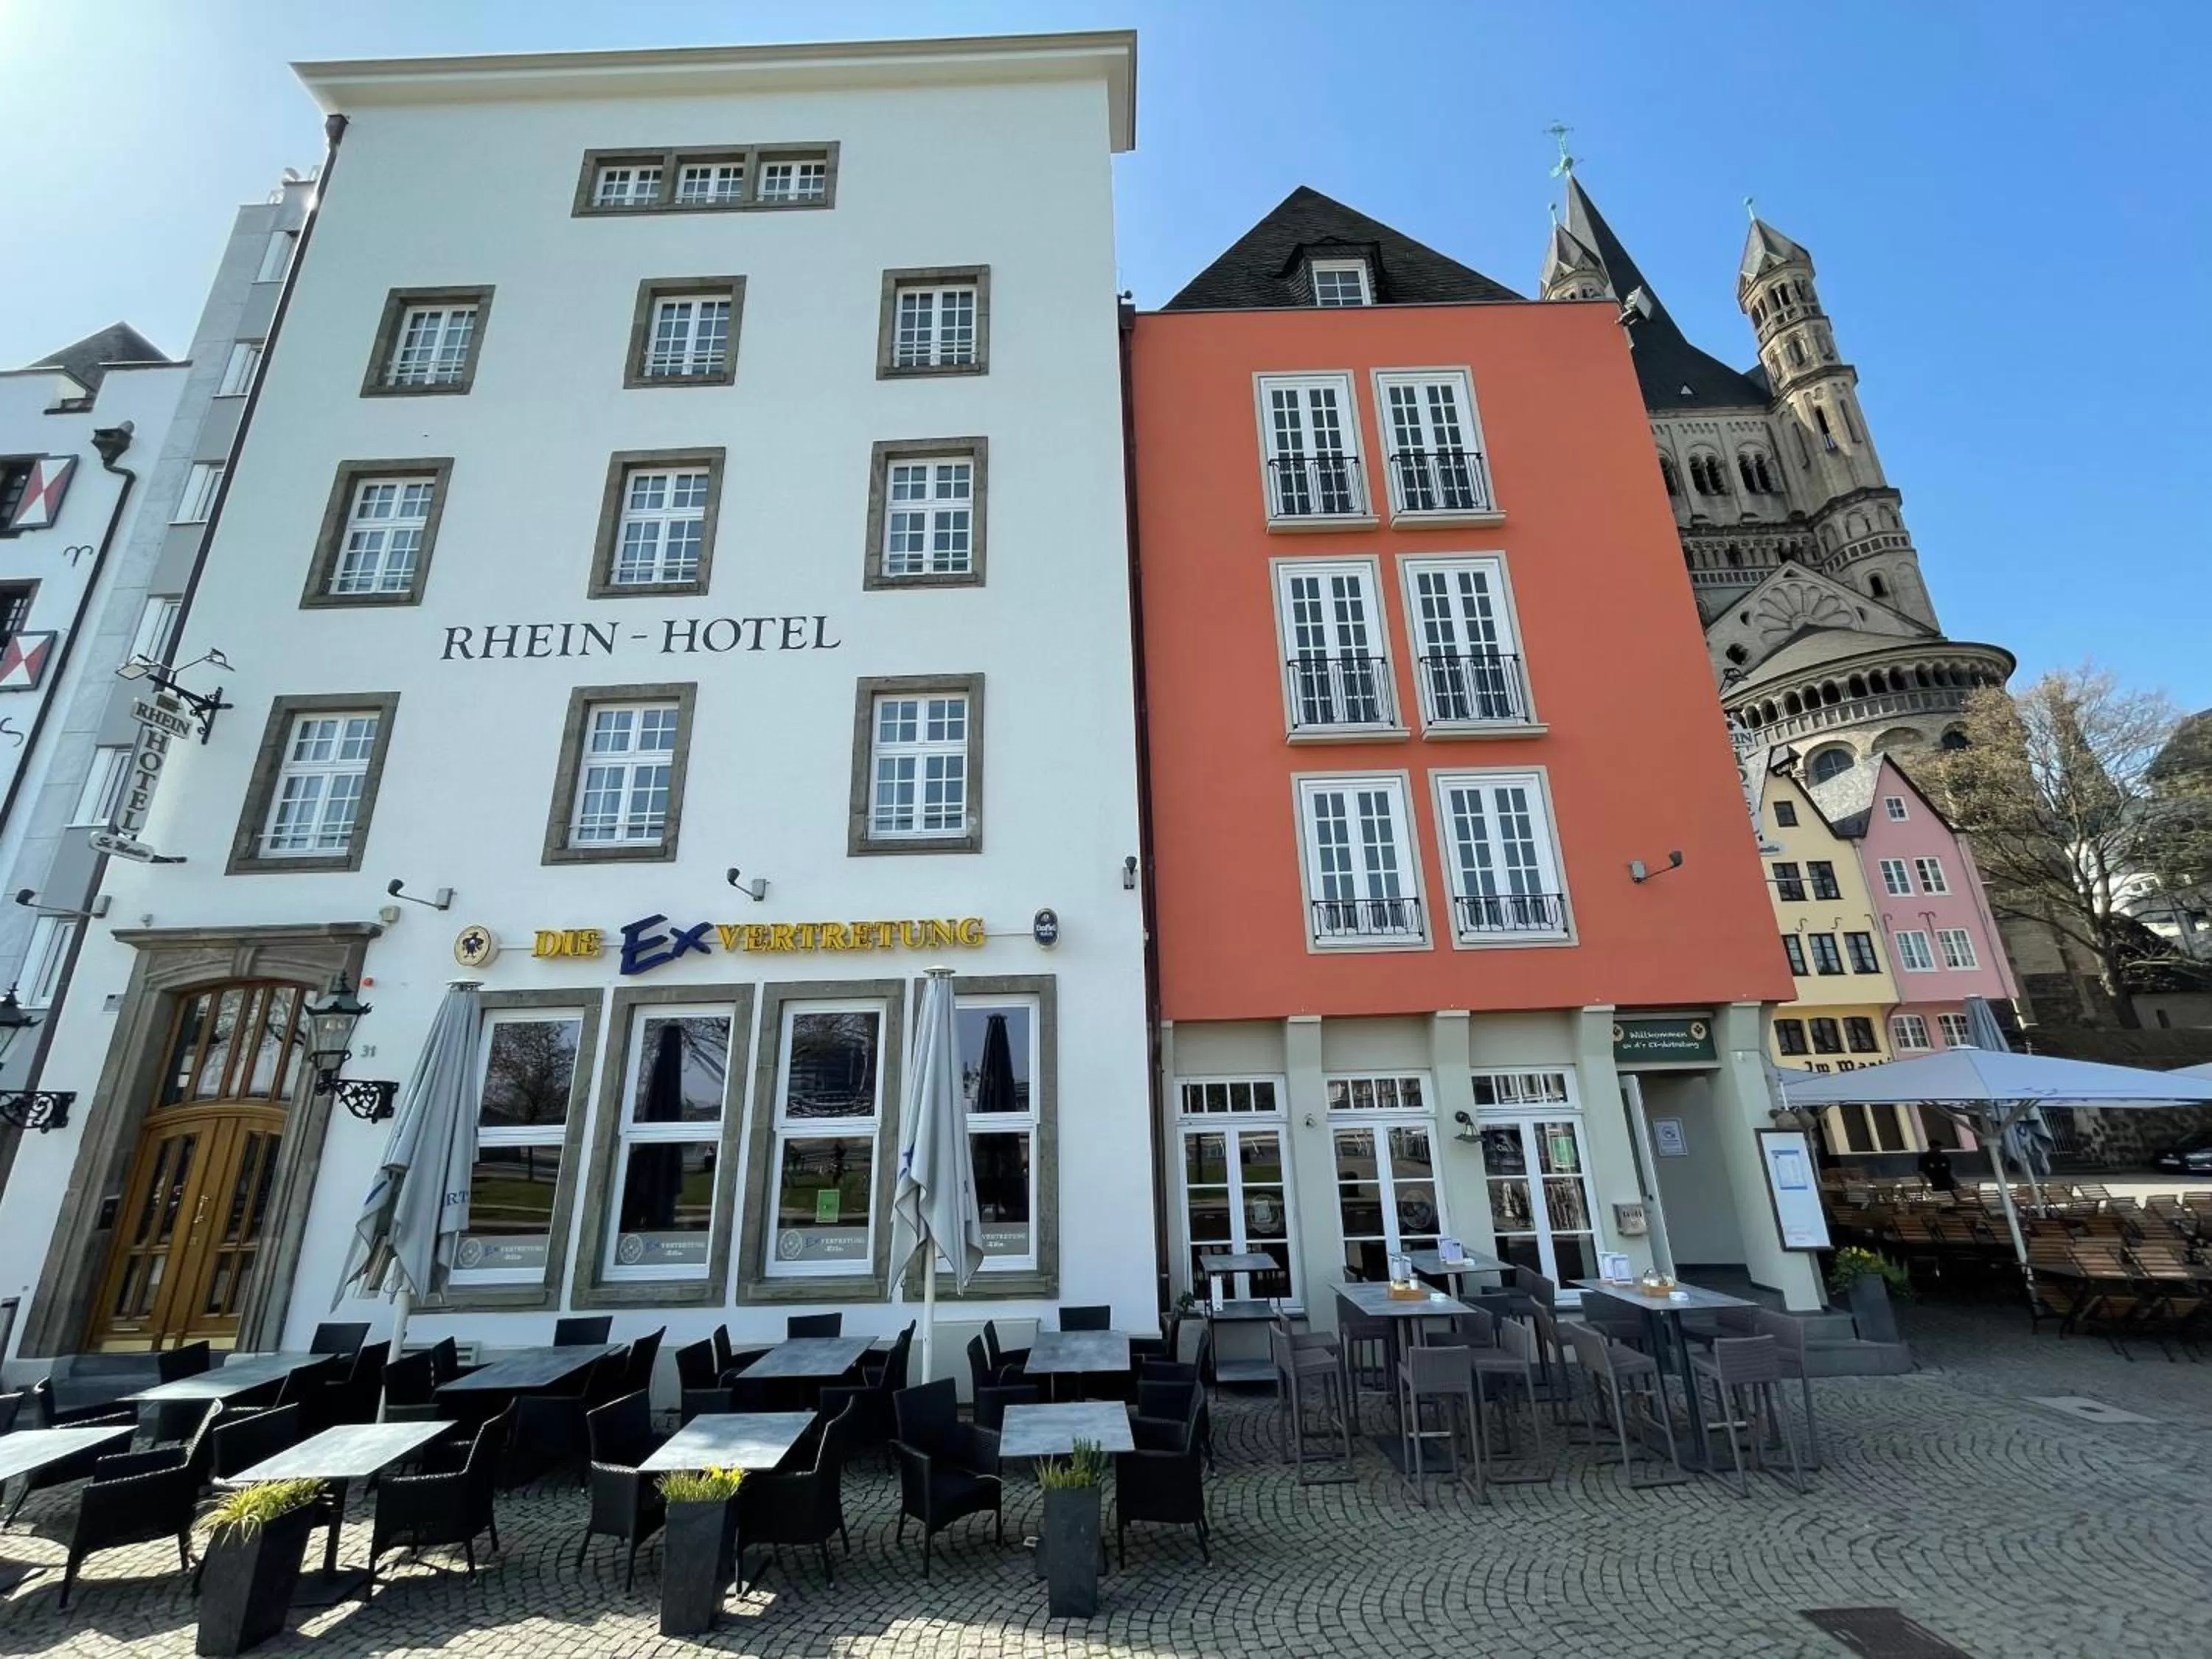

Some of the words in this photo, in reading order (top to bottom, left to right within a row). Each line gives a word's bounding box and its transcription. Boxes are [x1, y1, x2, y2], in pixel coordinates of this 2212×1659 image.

[440, 621, 620, 660] RHEIN
[661, 615, 842, 654] HOTEL
[135, 702, 192, 736] RHEIN
[122, 729, 170, 832] HOTEL
[532, 928, 604, 959] DIE
[360, 1043, 377, 1059] 31
